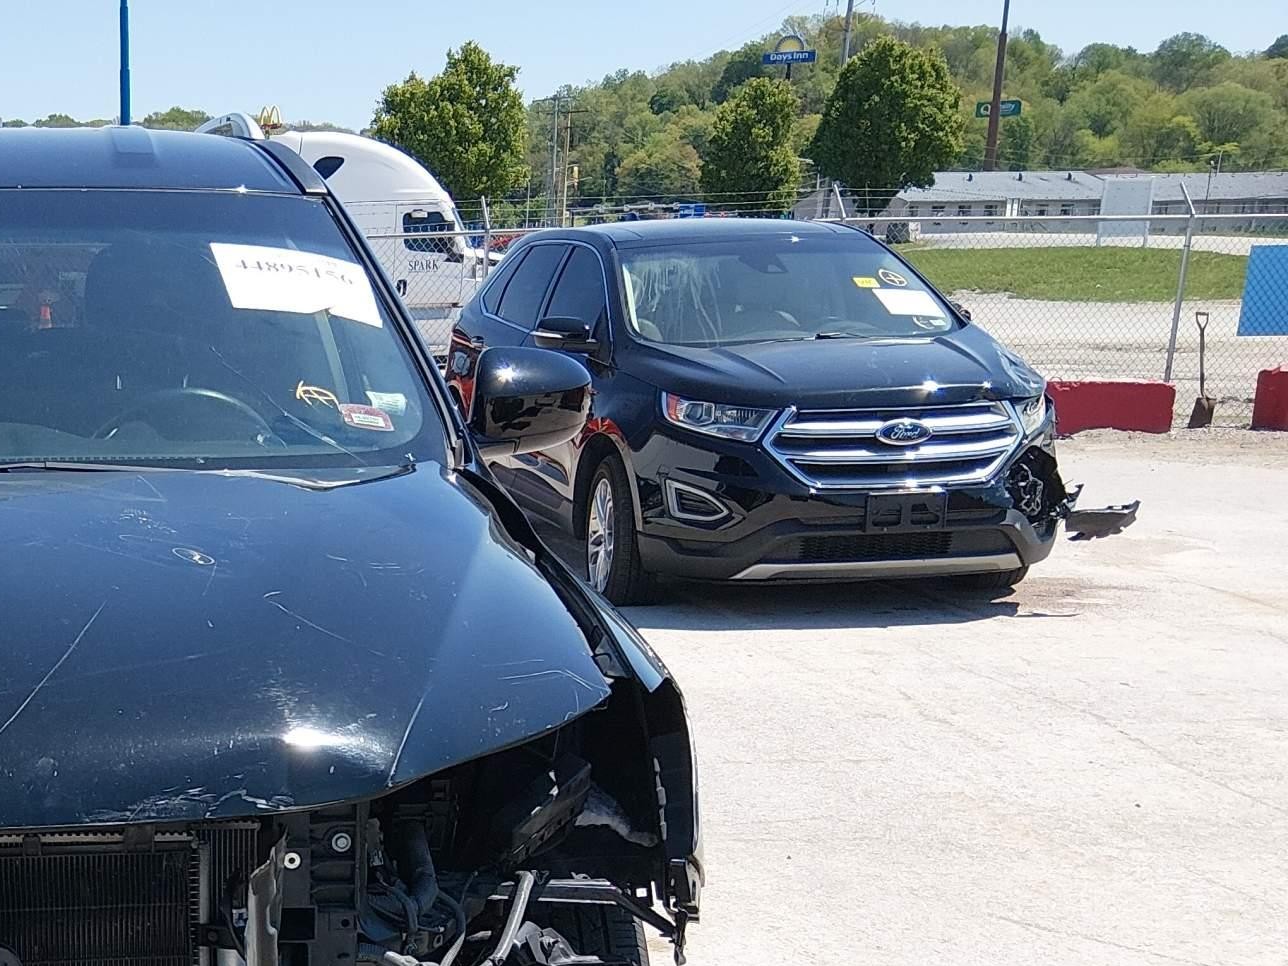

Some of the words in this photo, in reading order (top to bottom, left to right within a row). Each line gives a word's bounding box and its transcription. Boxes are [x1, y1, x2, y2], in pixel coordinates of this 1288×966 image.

[770, 53, 792, 62] Days
[793, 52, 809, 60] Inn
[408, 259, 439, 271] SPARK
[891, 423, 921, 440] Ford
